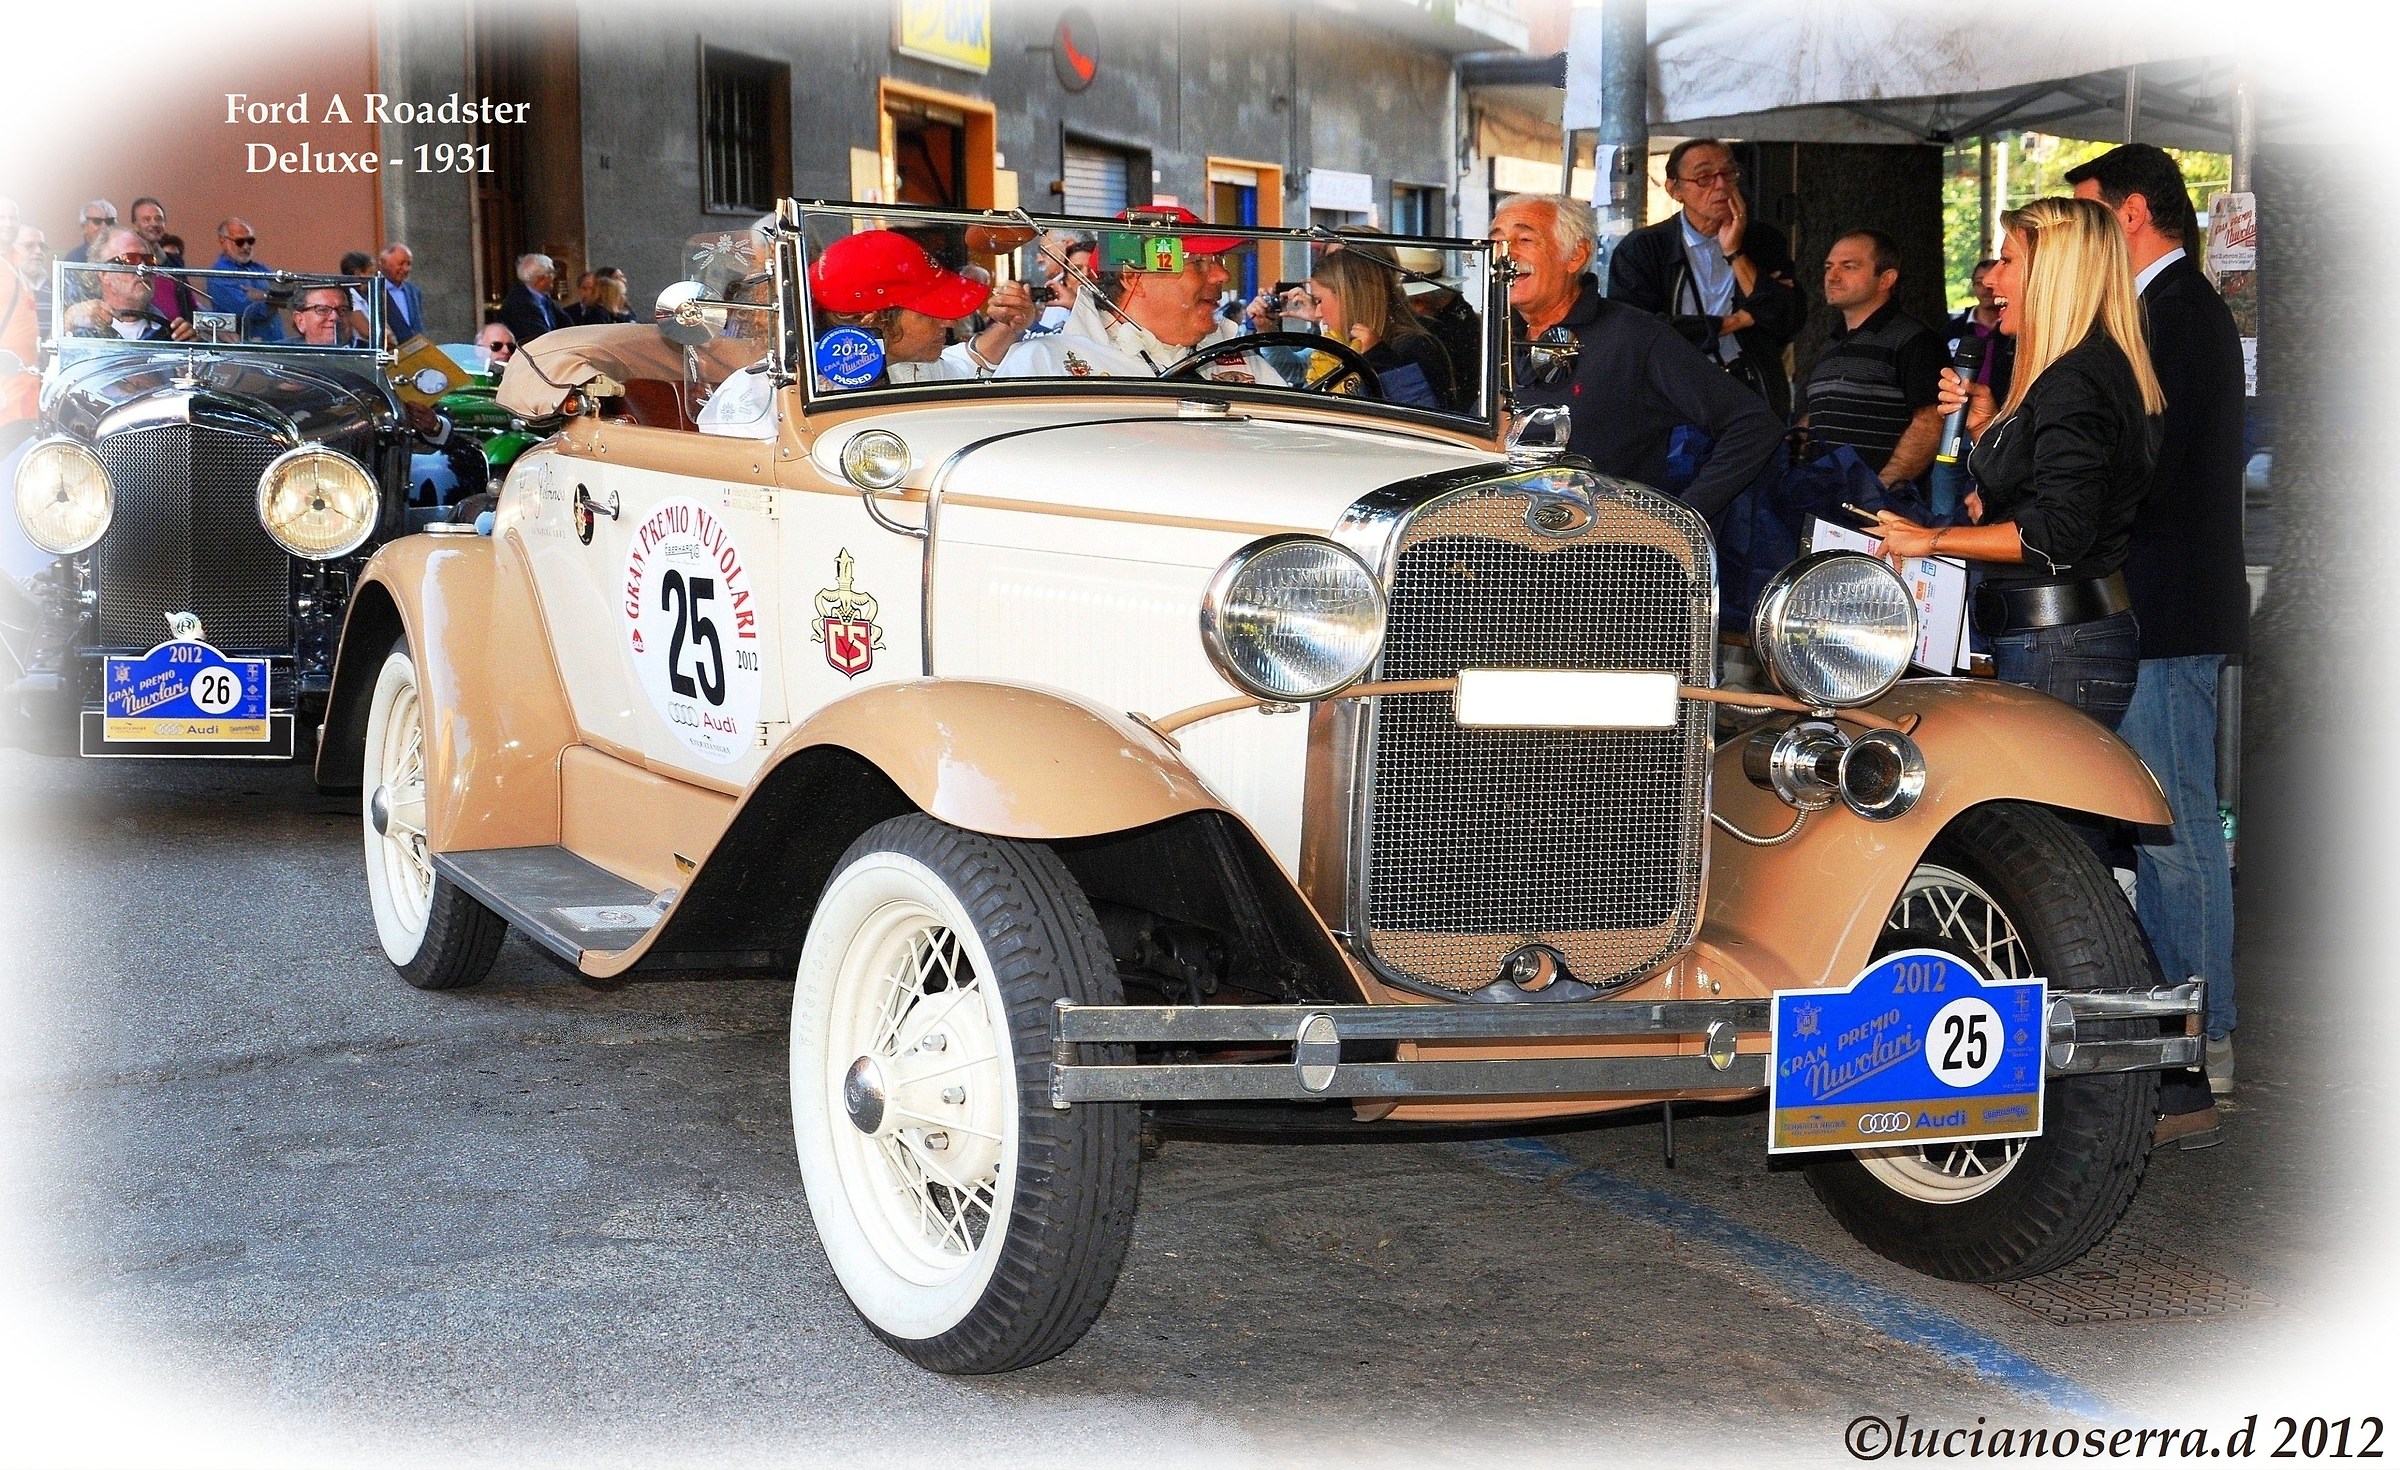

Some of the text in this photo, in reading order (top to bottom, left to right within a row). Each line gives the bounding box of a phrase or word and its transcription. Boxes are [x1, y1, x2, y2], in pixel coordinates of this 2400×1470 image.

[1156, 253, 1173, 268] 12
[832, 343, 869, 357] 2012
[839, 350, 880, 375] Nuvolari
[832, 373, 872, 385] PASSED
[625, 505, 757, 639] GRAN PREMIO NUVOLARI
[661, 568, 726, 707] 25
[169, 646, 203, 664] 2012
[736, 649, 758, 672] 2012
[108, 669, 176, 704] GRAN PREMIO
[121, 678, 189, 716] Nuvolari
[201, 675, 230, 705] 26
[186, 725, 219, 735] Audi
[703, 712, 737, 735] Audi
[1891, 960, 1947, 995] 2012
[1779, 1008, 1900, 1078] GRAN PREMIO
[1941, 1014, 1988, 1071] 25
[1803, 1024, 1922, 1100] Nuvolari
[1915, 1109, 1967, 1129] Audi
